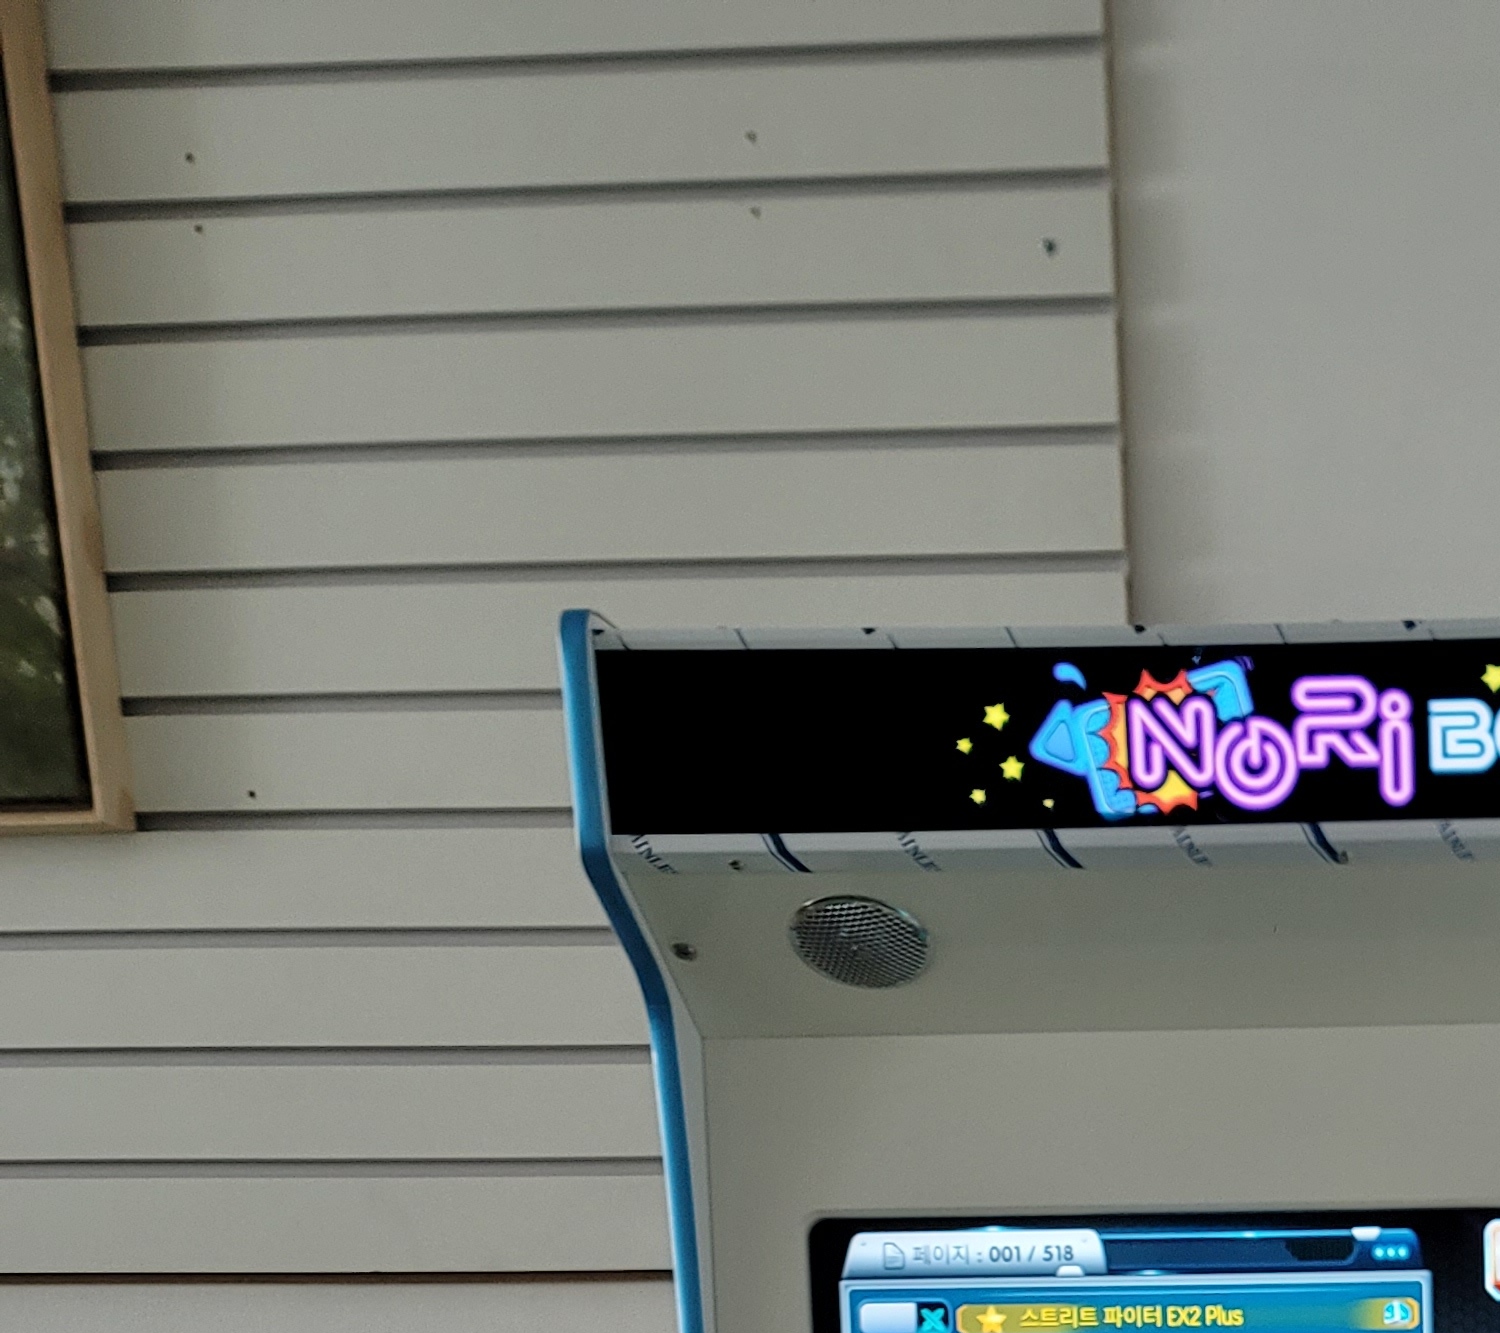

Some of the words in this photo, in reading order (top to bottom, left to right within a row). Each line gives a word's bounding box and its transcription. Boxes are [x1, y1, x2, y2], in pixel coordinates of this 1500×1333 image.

[911, 1238, 970, 1266] 페이지
[989, 1241, 1022, 1264] 001
[1043, 1241, 1074, 1263] 518
[1020, 1303, 1097, 1329] 스트리트
[1103, 1301, 1161, 1329] 파이터
[1166, 1303, 1201, 1328] EX2
[1204, 1303, 1244, 1327] Plus
